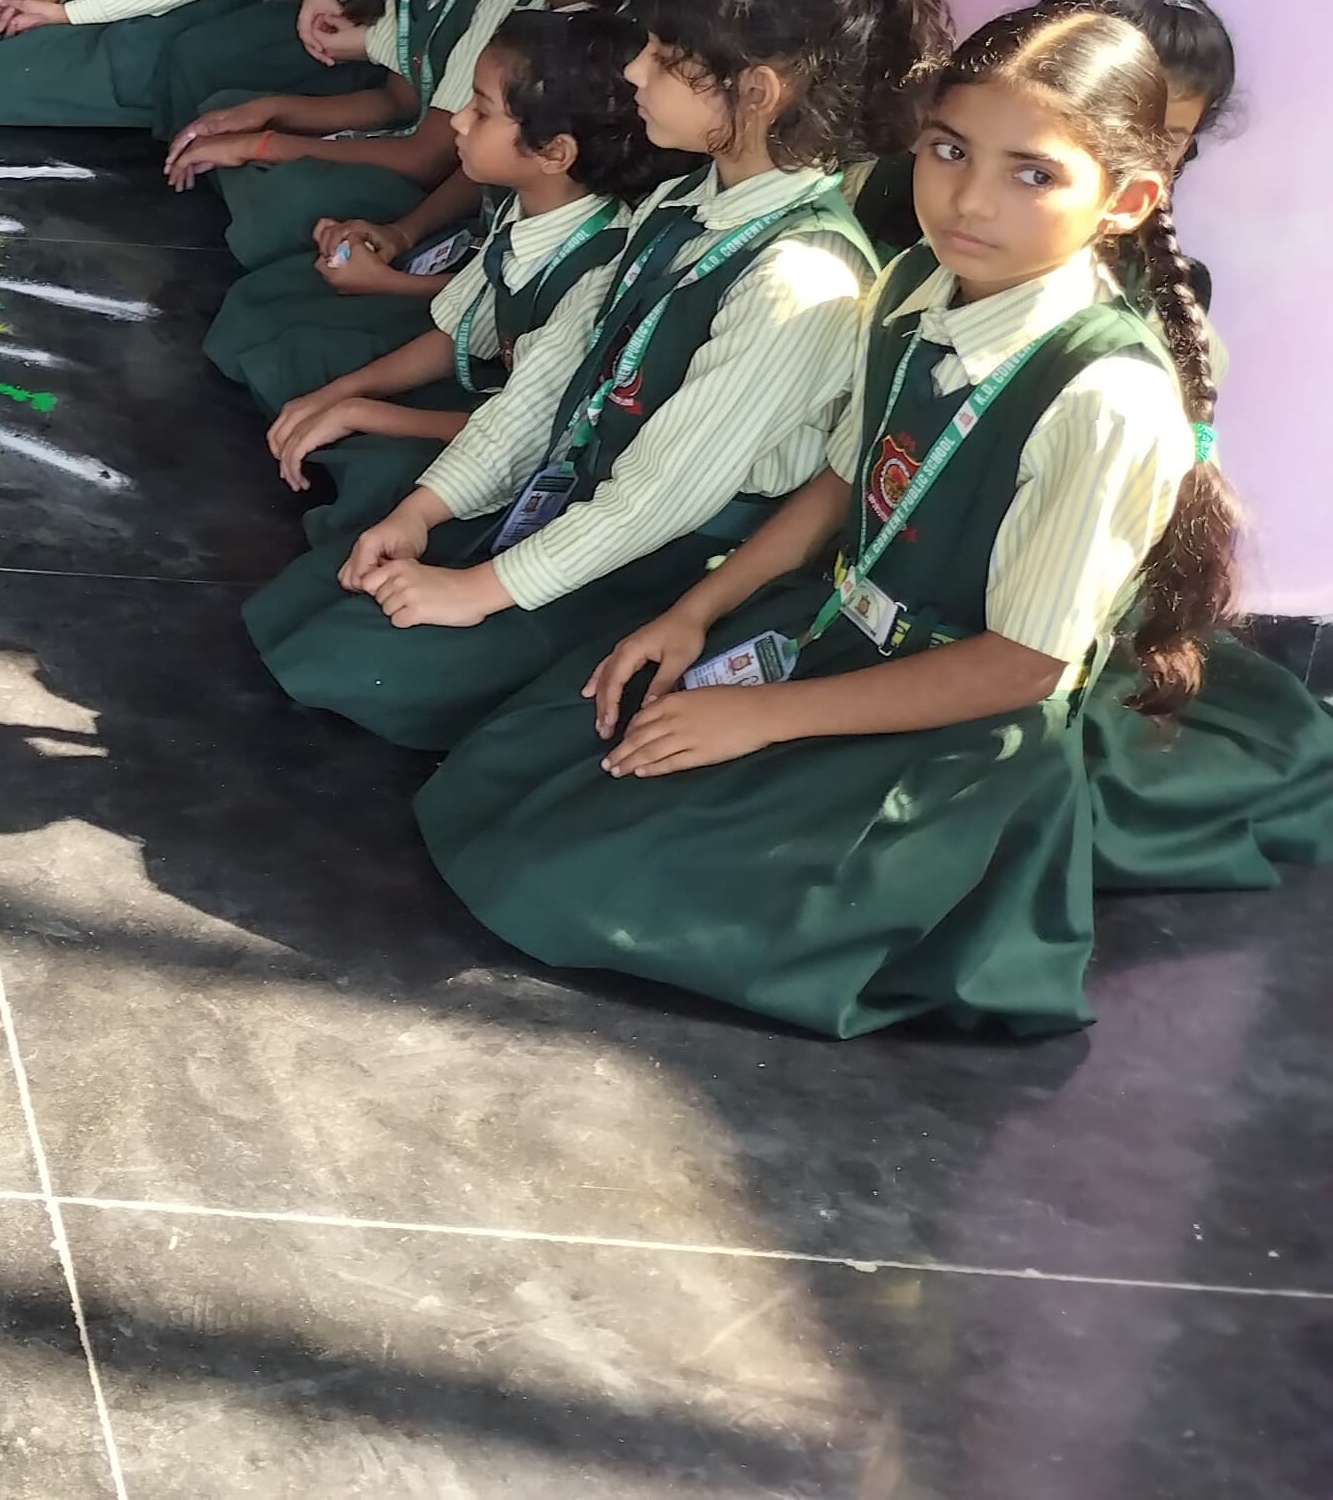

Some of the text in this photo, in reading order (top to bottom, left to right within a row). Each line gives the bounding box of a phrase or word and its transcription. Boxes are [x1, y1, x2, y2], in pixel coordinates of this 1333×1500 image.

[719, 220, 764, 259] CONVENT
[626, 323, 650, 359] PUBLIC
[973, 383, 998, 405] K.D.
[872, 507, 906, 556] CONVENT
[902, 472, 928, 514] PUBLIC
[924, 436, 957, 477] SCHOOL
